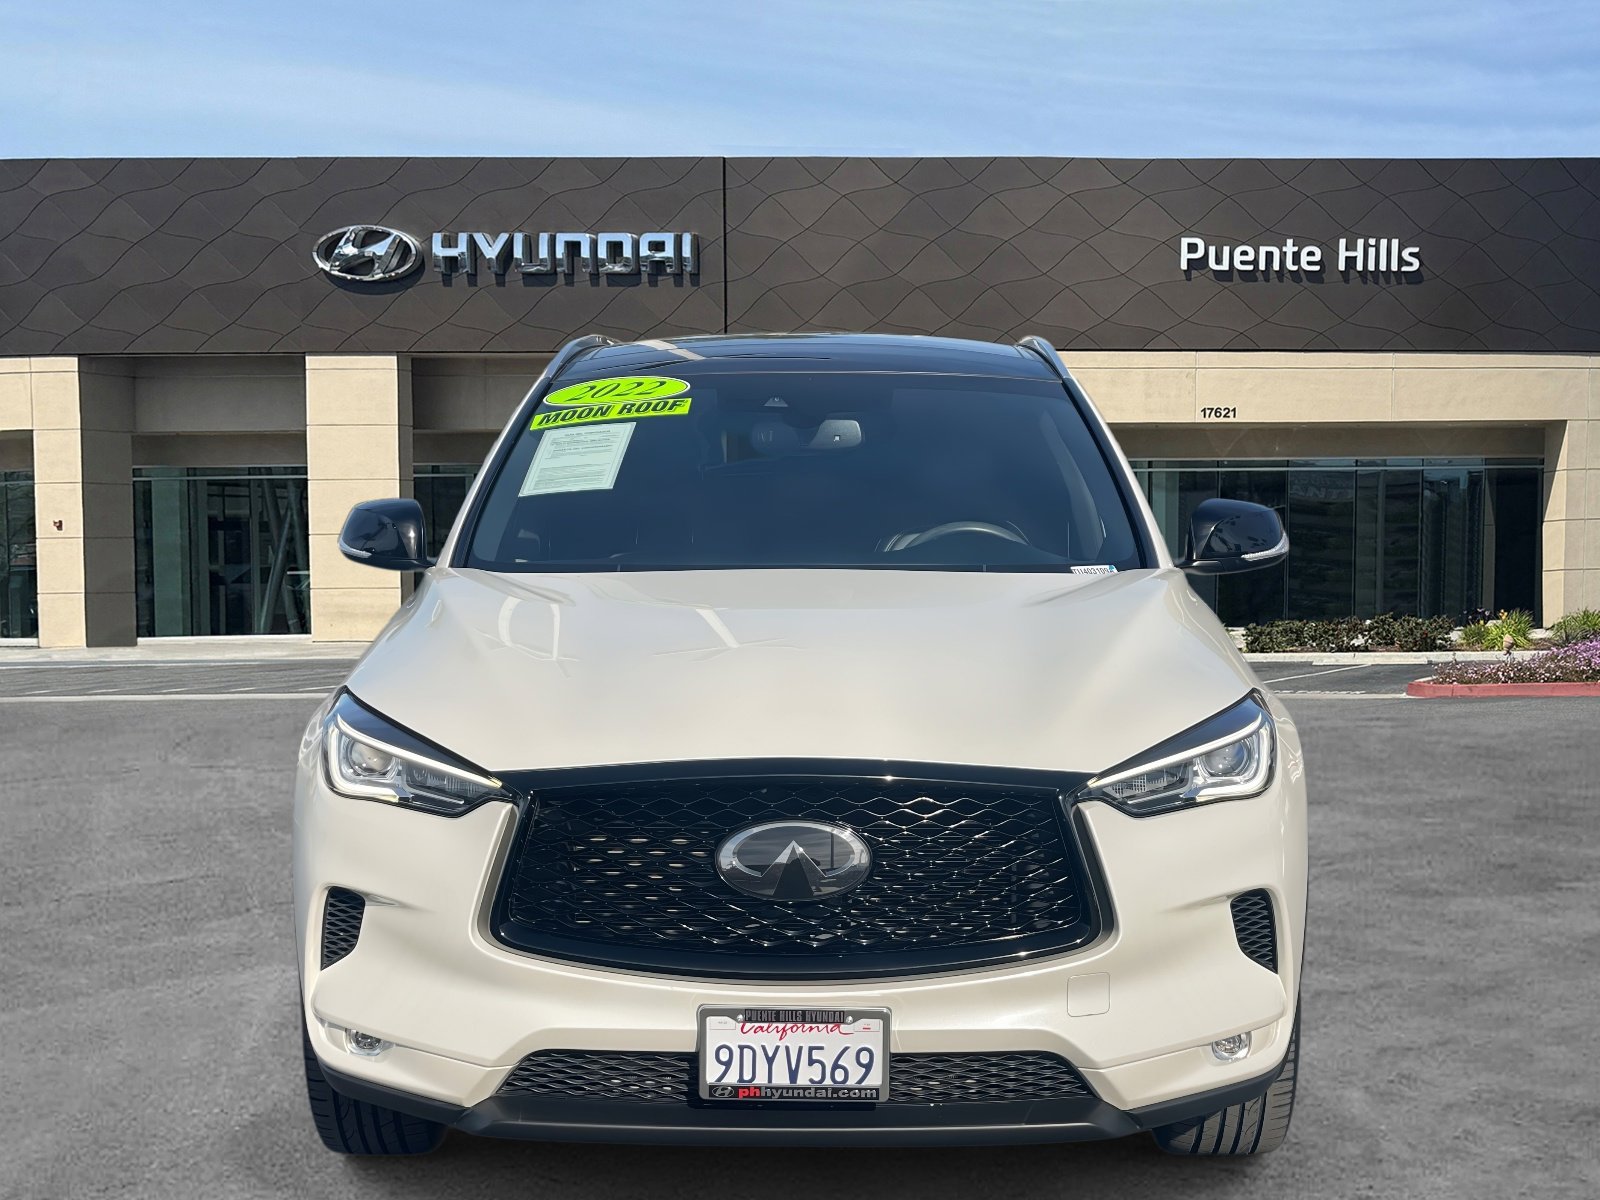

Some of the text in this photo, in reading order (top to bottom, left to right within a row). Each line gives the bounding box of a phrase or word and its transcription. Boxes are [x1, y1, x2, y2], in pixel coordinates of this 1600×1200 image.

[432, 232, 700, 275] HYUNDAI
[1180, 237, 1421, 272] Puente Hills
[565, 380, 667, 402] 2022
[537, 399, 687, 426] MOON ROOF
[1200, 406, 1237, 419] 17621
[745, 1009, 845, 1024] PUENTE HILLS HYUNDAI
[740, 1022, 855, 1041] California
[714, 1043, 875, 1085] 9DYV569
[738, 1085, 877, 1099] phhyundai.com
